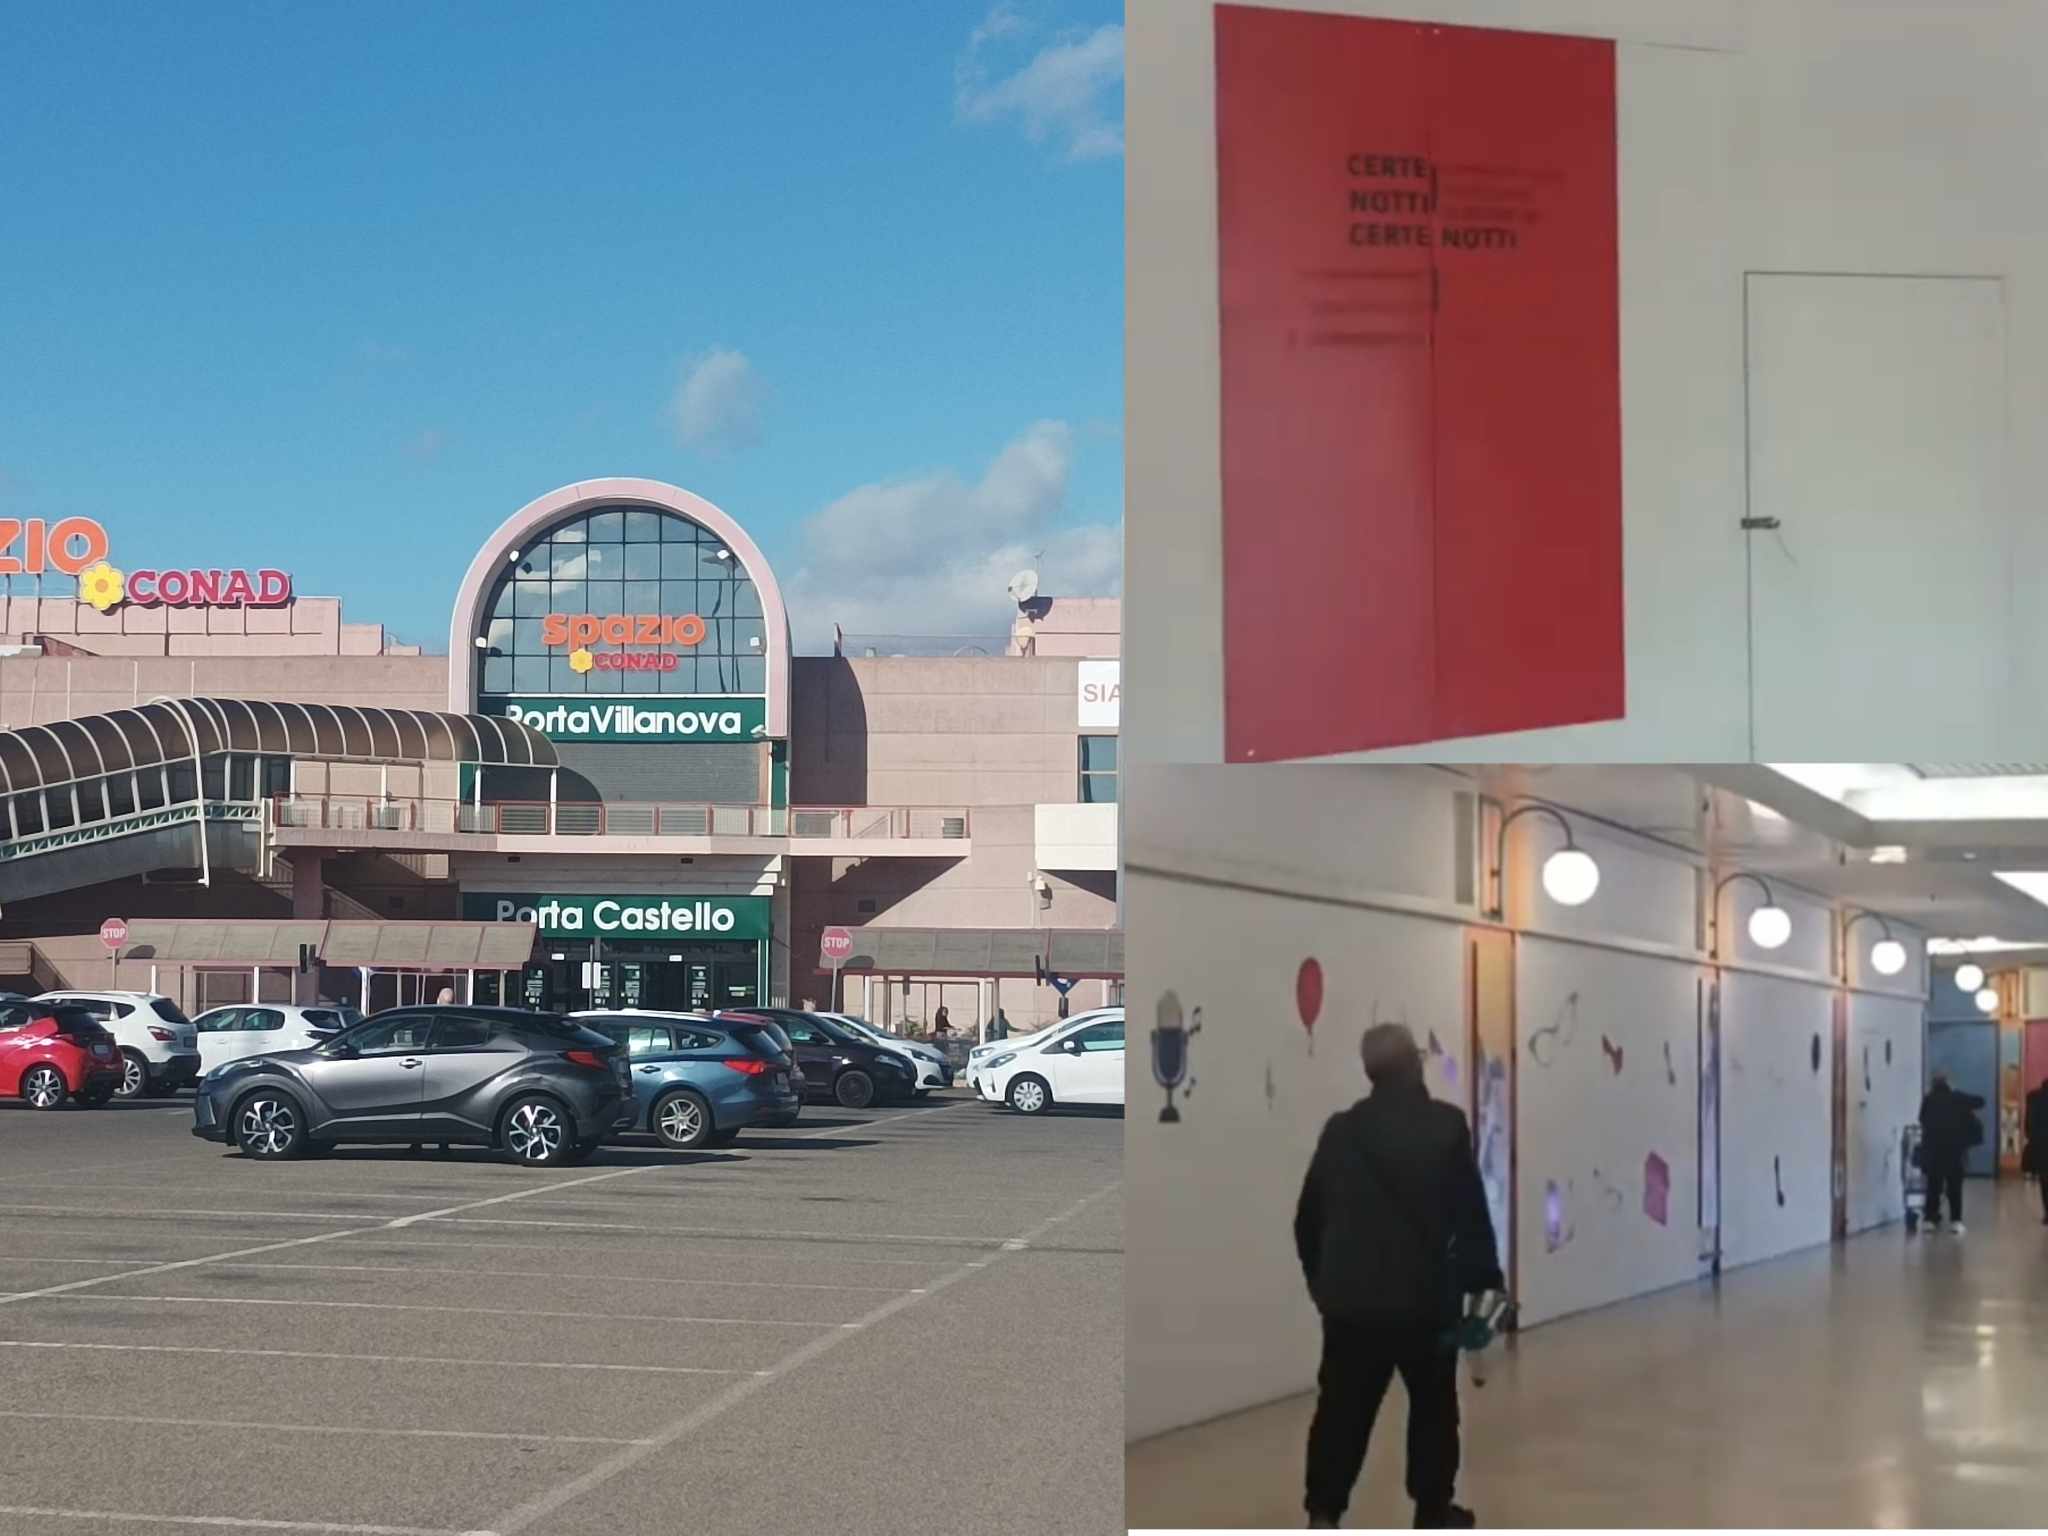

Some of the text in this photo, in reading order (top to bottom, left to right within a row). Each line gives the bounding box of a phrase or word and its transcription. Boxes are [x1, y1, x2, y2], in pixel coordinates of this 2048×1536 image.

[1347, 153, 1430, 179] CERTE
[1350, 189, 1430, 215] NOTTI
[1348, 224, 1518, 249] CERTE NOTTI
[128, 569, 291, 605] CONAD
[542, 613, 706, 649] spazio
[594, 652, 679, 671] CONAD
[497, 900, 735, 931] Porta Castello
[101, 927, 127, 939] STOP
[823, 937, 850, 949] STOP
